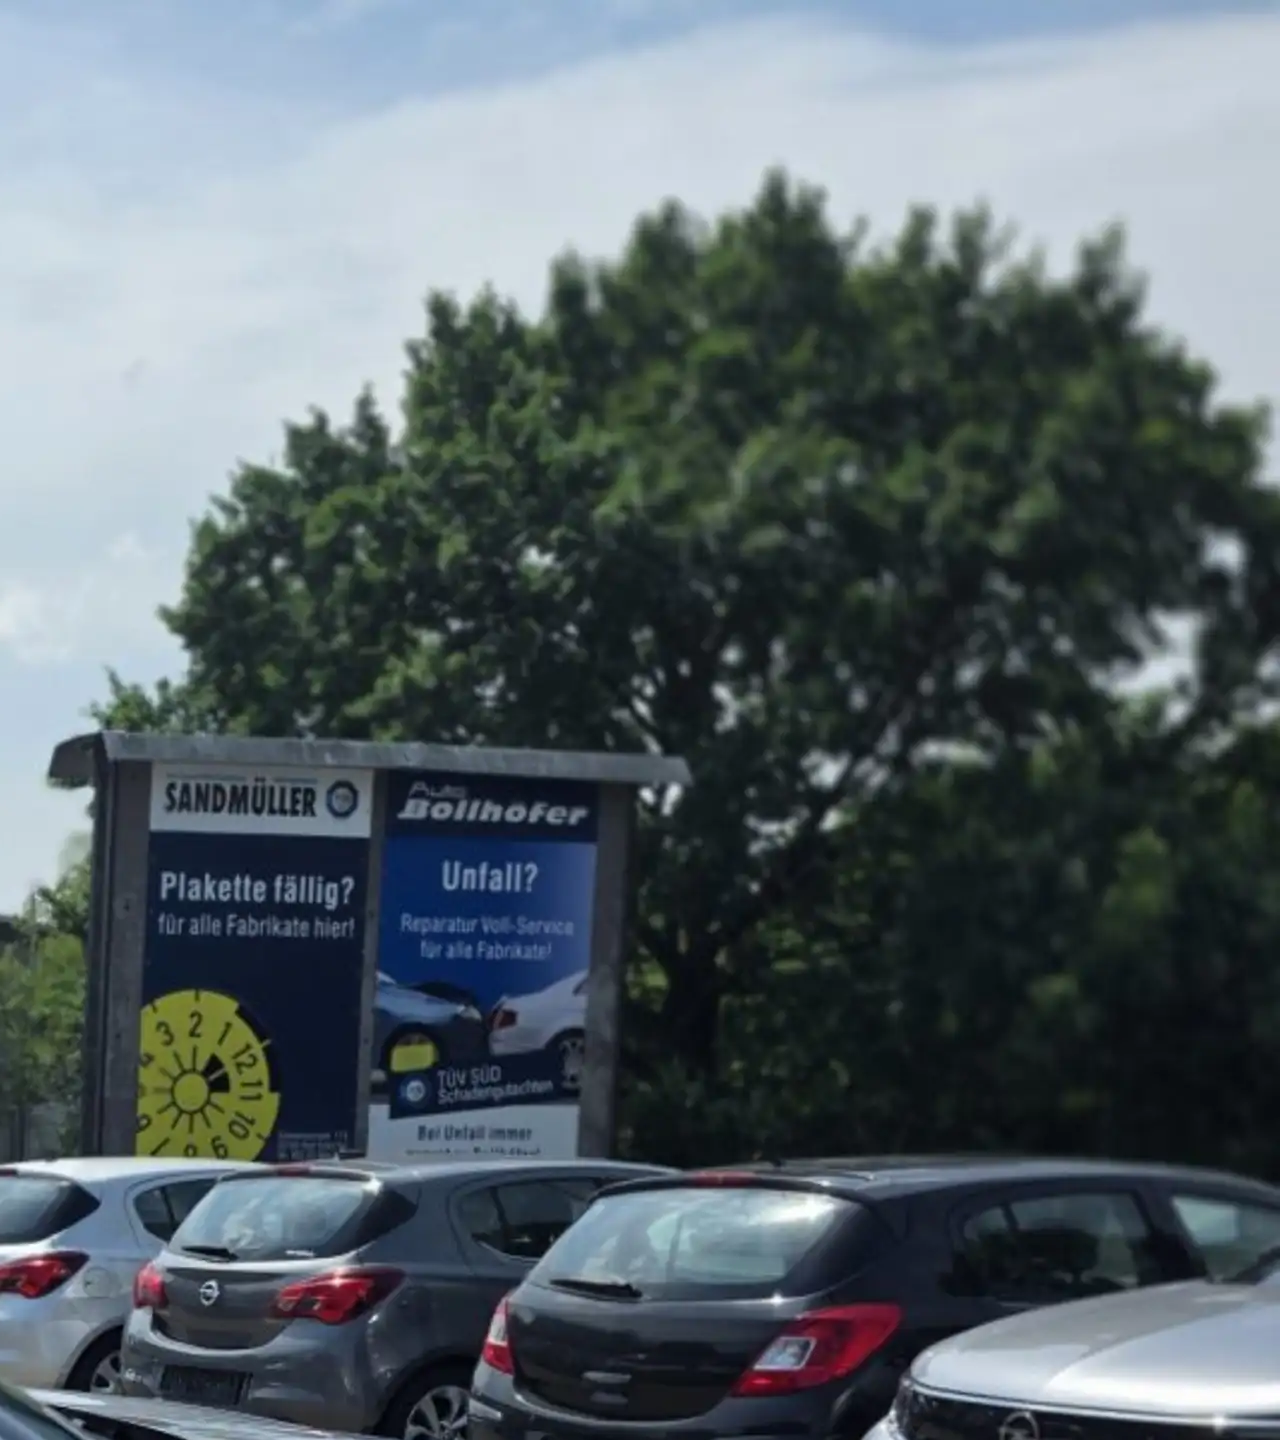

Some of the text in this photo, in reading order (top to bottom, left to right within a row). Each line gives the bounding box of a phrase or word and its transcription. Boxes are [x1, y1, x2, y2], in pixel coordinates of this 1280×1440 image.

[164, 776, 318, 818] SANDMÜLLER
[441, 859, 539, 893] Unfall?
[159, 871, 356, 911] Plakette fällig?
[157, 912, 356, 940] für alle Fabrikate hier!
[400, 912, 575, 936] Reparatur Voll-Service
[419, 939, 552, 961] für alle Fabrikate!
[188, 1010, 203, 1039] 2
[231, 1042, 258, 1076] 12
[437, 1065, 503, 1089] TÜV SÜD
[417, 1125, 533, 1142] Bei Unfall immer
